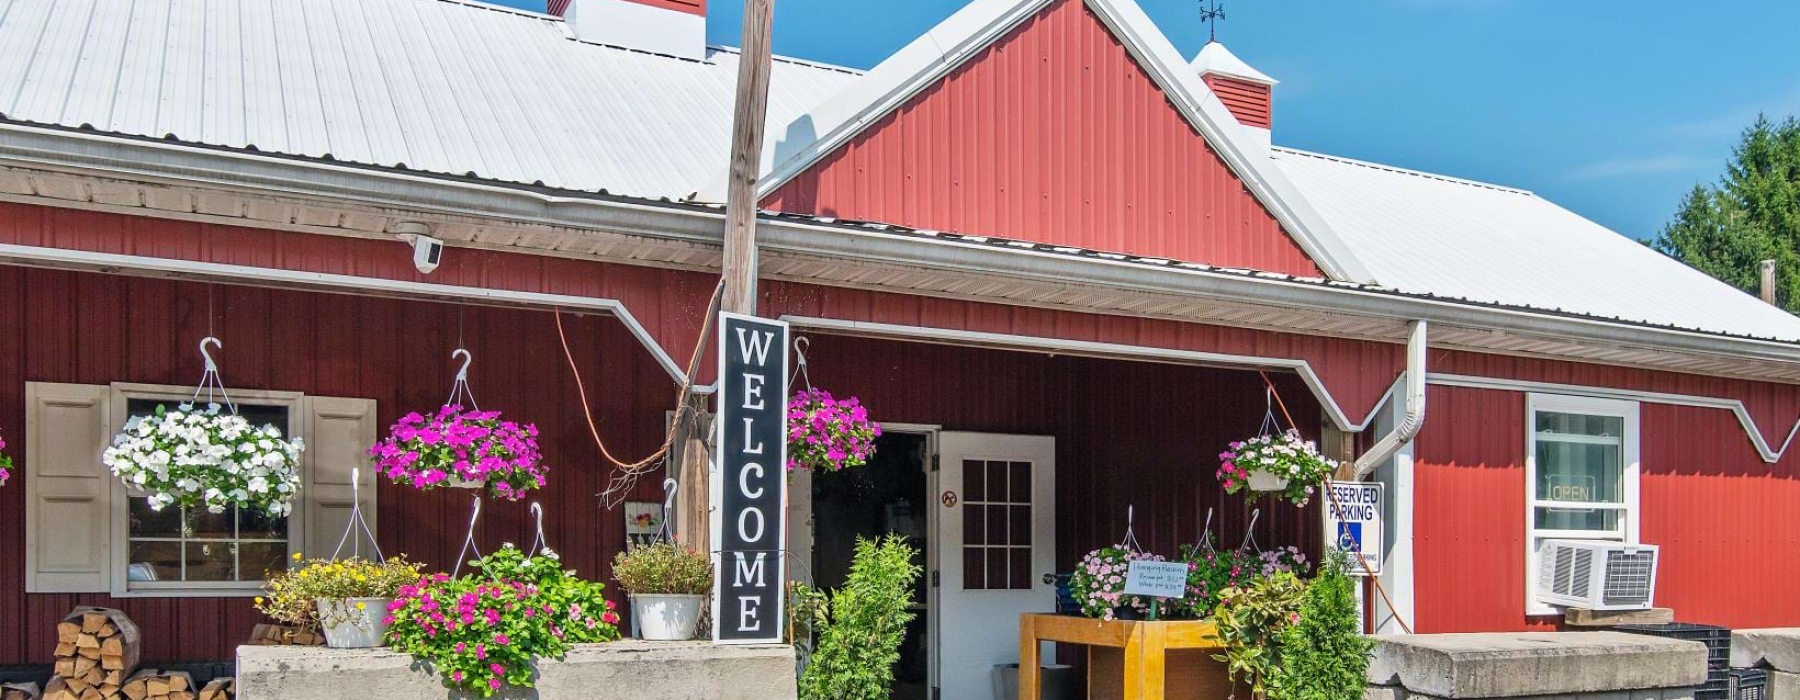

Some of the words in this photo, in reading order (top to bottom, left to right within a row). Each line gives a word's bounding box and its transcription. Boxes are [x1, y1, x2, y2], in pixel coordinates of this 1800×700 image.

[733, 327, 775, 632] WELCOME
[1326, 487, 1378, 503] RESERVED
[1553, 485, 1588, 501] OPEN
[1329, 505, 1373, 520] PARKING
